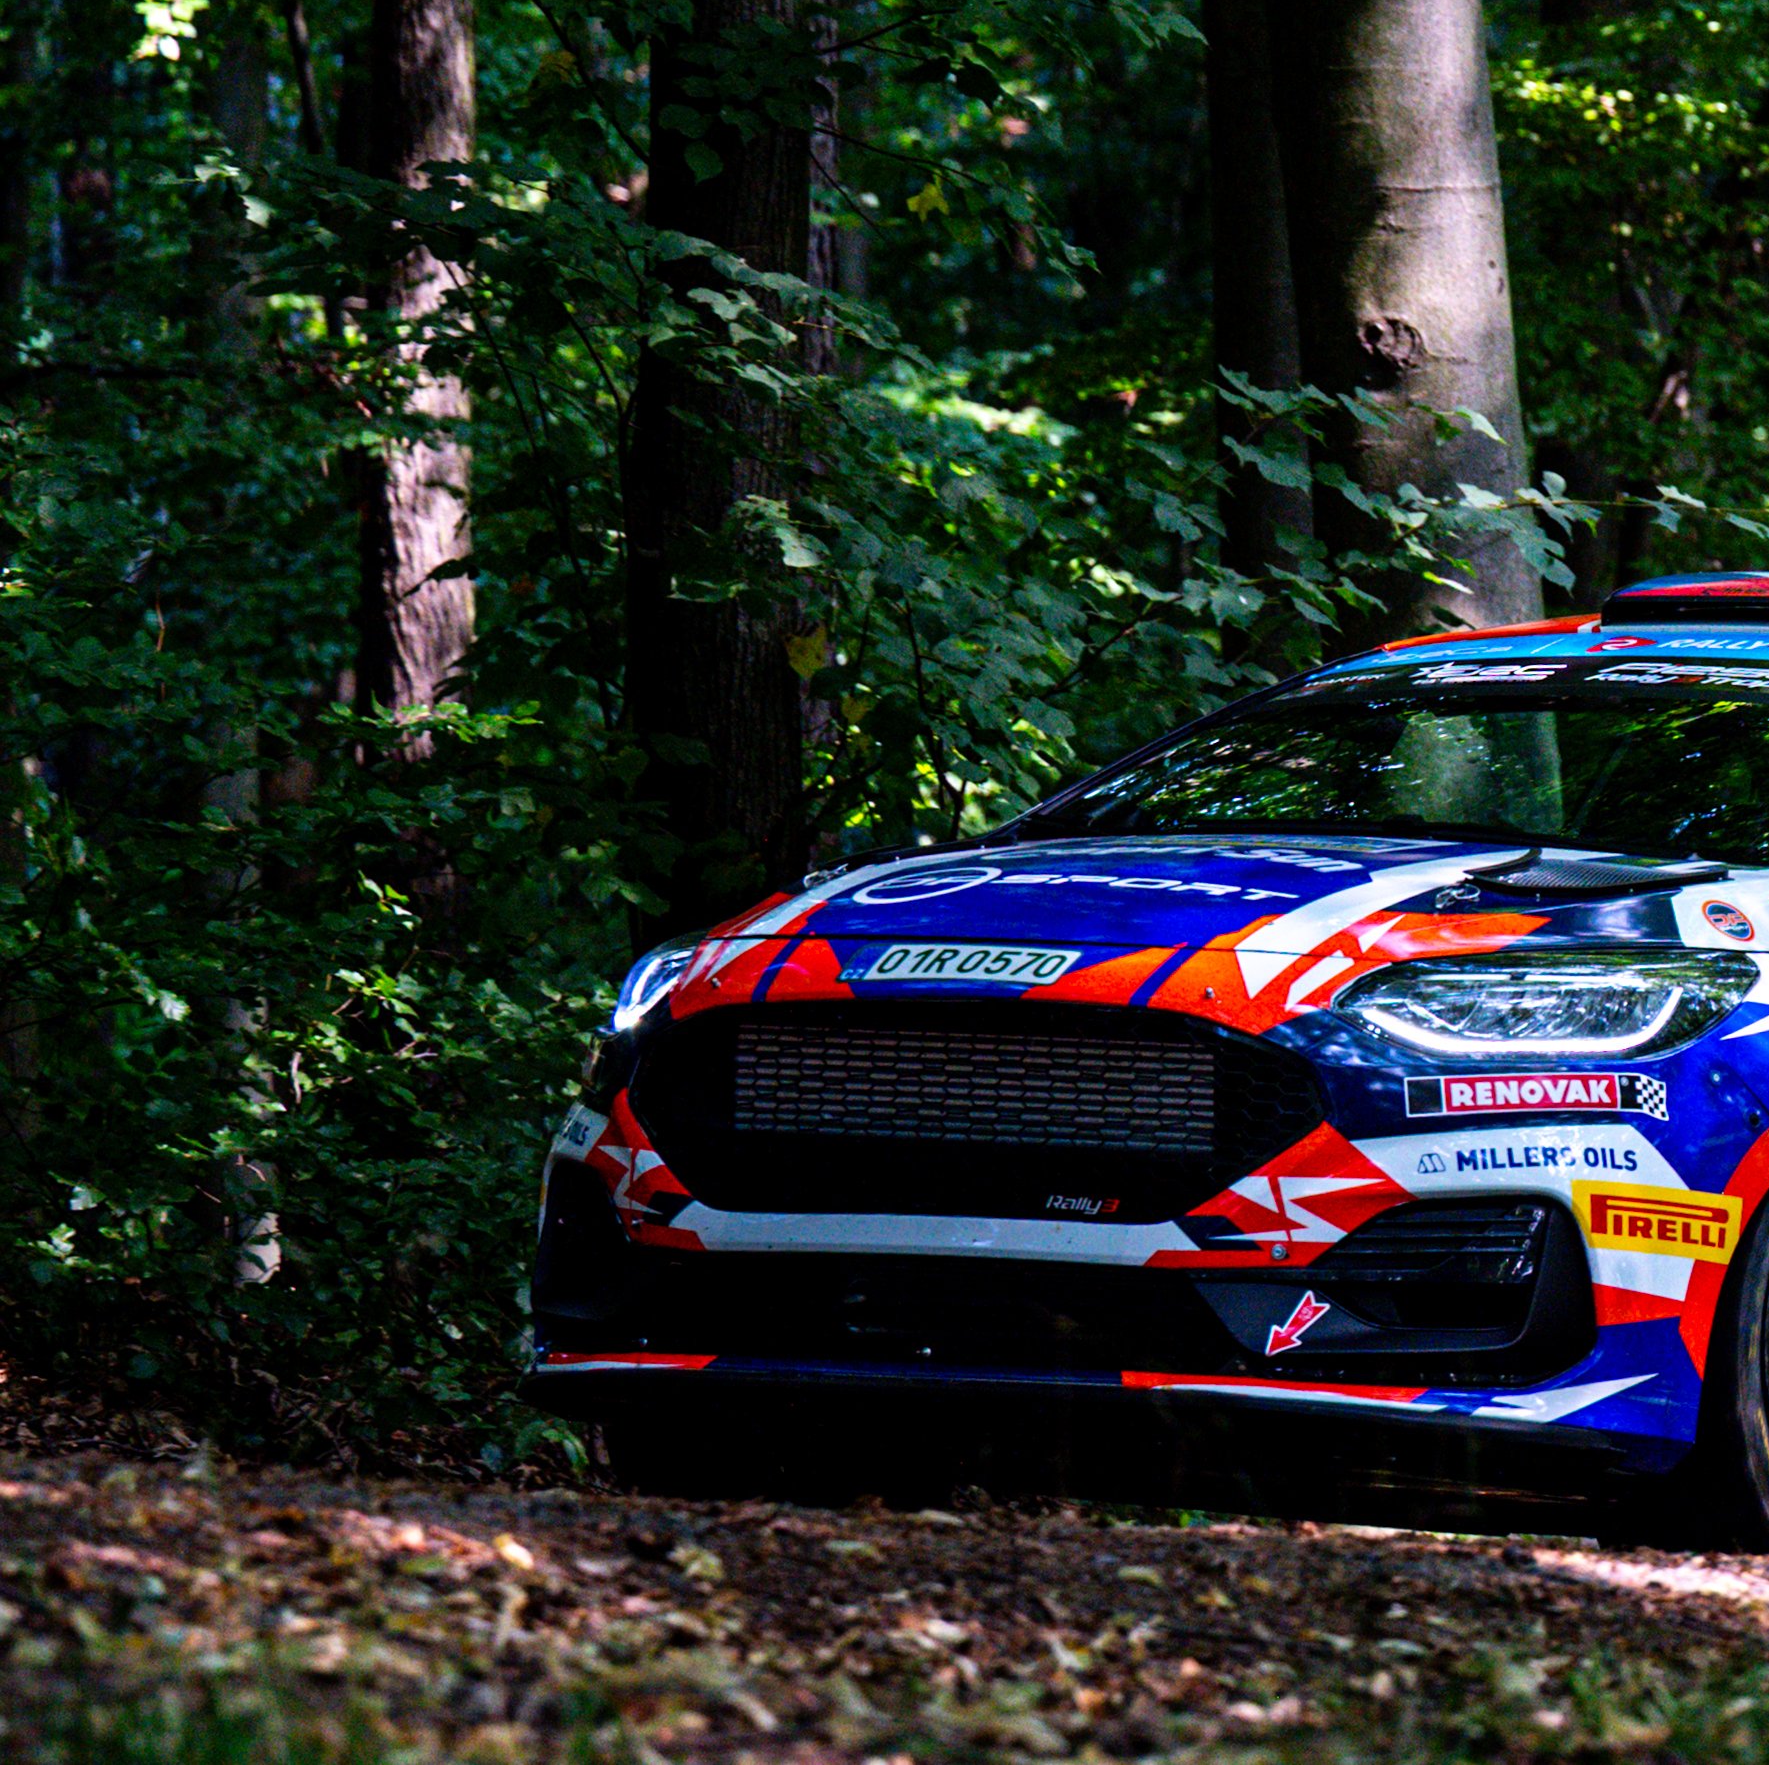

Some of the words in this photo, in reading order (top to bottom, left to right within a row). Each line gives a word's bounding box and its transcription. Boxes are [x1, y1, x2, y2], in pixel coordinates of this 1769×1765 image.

[992, 873, 1301, 901] SPORT
[1449, 1079, 1612, 1108] RENOVAK
[1456, 1146, 1577, 1173] MILLERS
[1583, 1146, 1638, 1171] OILS
[1590, 1193, 1730, 1250] PIRELLI
